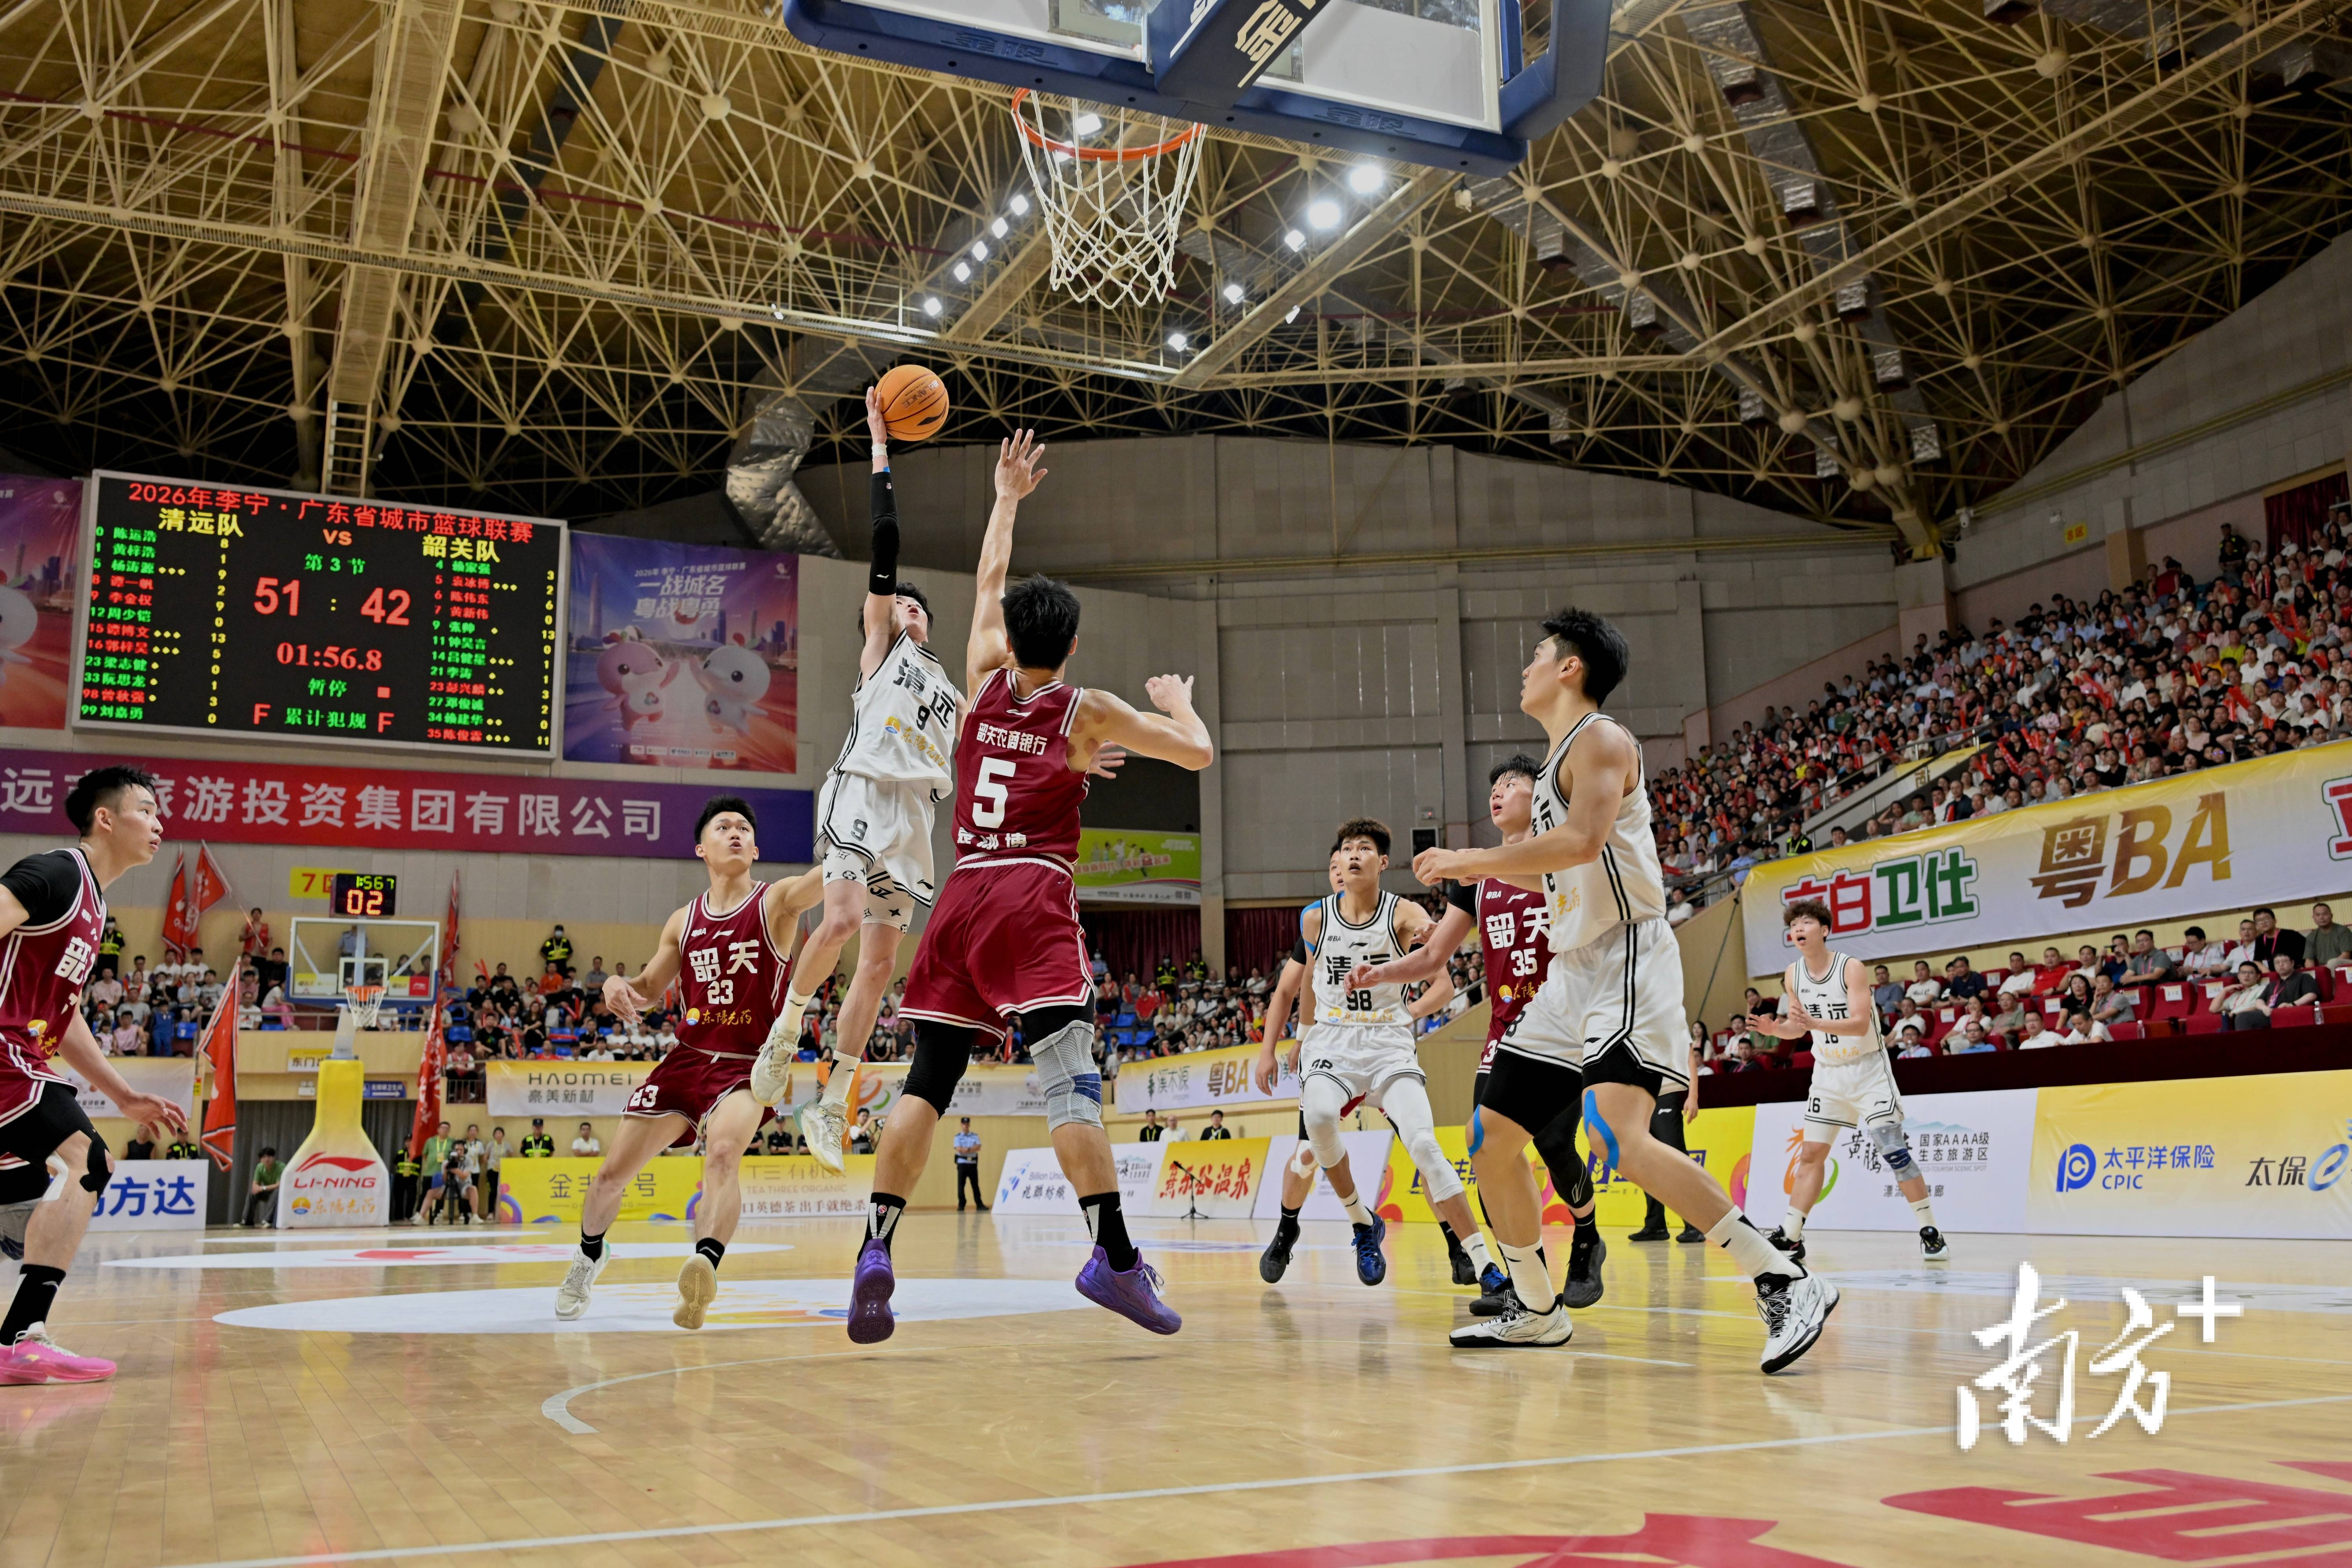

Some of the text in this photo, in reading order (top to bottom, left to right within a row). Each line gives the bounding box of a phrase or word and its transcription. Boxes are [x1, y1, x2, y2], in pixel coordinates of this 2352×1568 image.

[158, 508, 243, 537] 清远队
[96, 526, 104, 536] 0
[221, 539, 229, 548] 8
[96, 543, 100, 552] 1
[221, 555, 226, 564] 1
[422, 534, 500, 562] 韶关队
[93, 558, 226, 579] 5 9
[436, 560, 443, 569] 4
[548, 571, 554, 580] 3
[91, 574, 100, 584] 8
[218, 586, 225, 595] 2
[436, 575, 443, 584] 5
[547, 585, 554, 595] 2
[91, 591, 99, 600] 9
[216, 601, 224, 611] 9
[254, 577, 299, 616] 51
[361, 588, 410, 625] 42
[435, 590, 442, 599] 6
[546, 601, 553, 610] 6
[91, 607, 105, 617] 12
[215, 617, 223, 627] 0
[435, 606, 441, 614] 7
[545, 615, 552, 624] 0
[90, 623, 104, 633] 15
[212, 633, 225, 643] 13
[433, 621, 440, 630] 9
[542, 630, 555, 640] 13
[89, 639, 103, 649] 16
[213, 649, 221, 659] 5
[433, 636, 445, 645] 11
[544, 645, 551, 654] 0
[86, 656, 101, 666] 23
[212, 665, 220, 674] 0
[277, 642, 382, 671] 01:56.8
[433, 651, 445, 660] 14
[544, 661, 549, 669] 1
[84, 672, 100, 682] 33
[212, 681, 217, 690] 1
[431, 666, 443, 675] 21
[544, 675, 548, 684] 1
[82, 689, 99, 699] 98
[210, 697, 217, 706] 3
[309, 678, 347, 697] 暂停
[430, 682, 444, 691] 23
[542, 690, 549, 699] 3
[893, 657, 955, 730] 清远
[81, 705, 97, 715] 99
[208, 713, 216, 723] 0
[254, 704, 271, 724] F
[429, 697, 443, 706] 27
[542, 705, 548, 714] 2
[285, 708, 366, 728] 累计犯规
[378, 712, 394, 733] F
[428, 712, 548, 729] 34 0
[916, 705, 930, 731] 9
[428, 729, 441, 738] 35
[538, 736, 549, 745] 11
[976, 722, 1047, 756] 韶关农商银行
[972, 756, 1016, 828] 5
[1, 768, 661, 841] 远游投资集团有限公司
[851, 818, 868, 842] 9
[2029, 790, 2234, 909] 粤BA
[347, 889, 383, 915] 02
[689, 939, 759, 982] 韶关
[1510, 948, 1537, 976] 35
[707, 980, 734, 1004] 23
[1347, 990, 1372, 1011] 98
[1505, 1010, 1526, 1038] 8
[1483, 1039, 1497, 1063] 3
[528, 1073, 632, 1085] HAOMEI
[1207, 1059, 1250, 1097] 粤BA
[629, 1085, 659, 1108] 23
[1808, 1097, 1820, 1113] 16
[1920, 1132, 1989, 1147] 国家AAAA级
[1918, 1147, 1988, 1162] 生态旅游区
[2103, 1145, 2215, 1170] 太平洋保险
[294, 1177, 376, 1189] LI-NING
[549, 1173, 656, 1198] 金号
[768, 1185, 798, 1194] THREE
[801, 1184, 847, 1193] ORGANIC
[2102, 1174, 2143, 1190] CPIC
[91, 1176, 196, 1217] 方达
